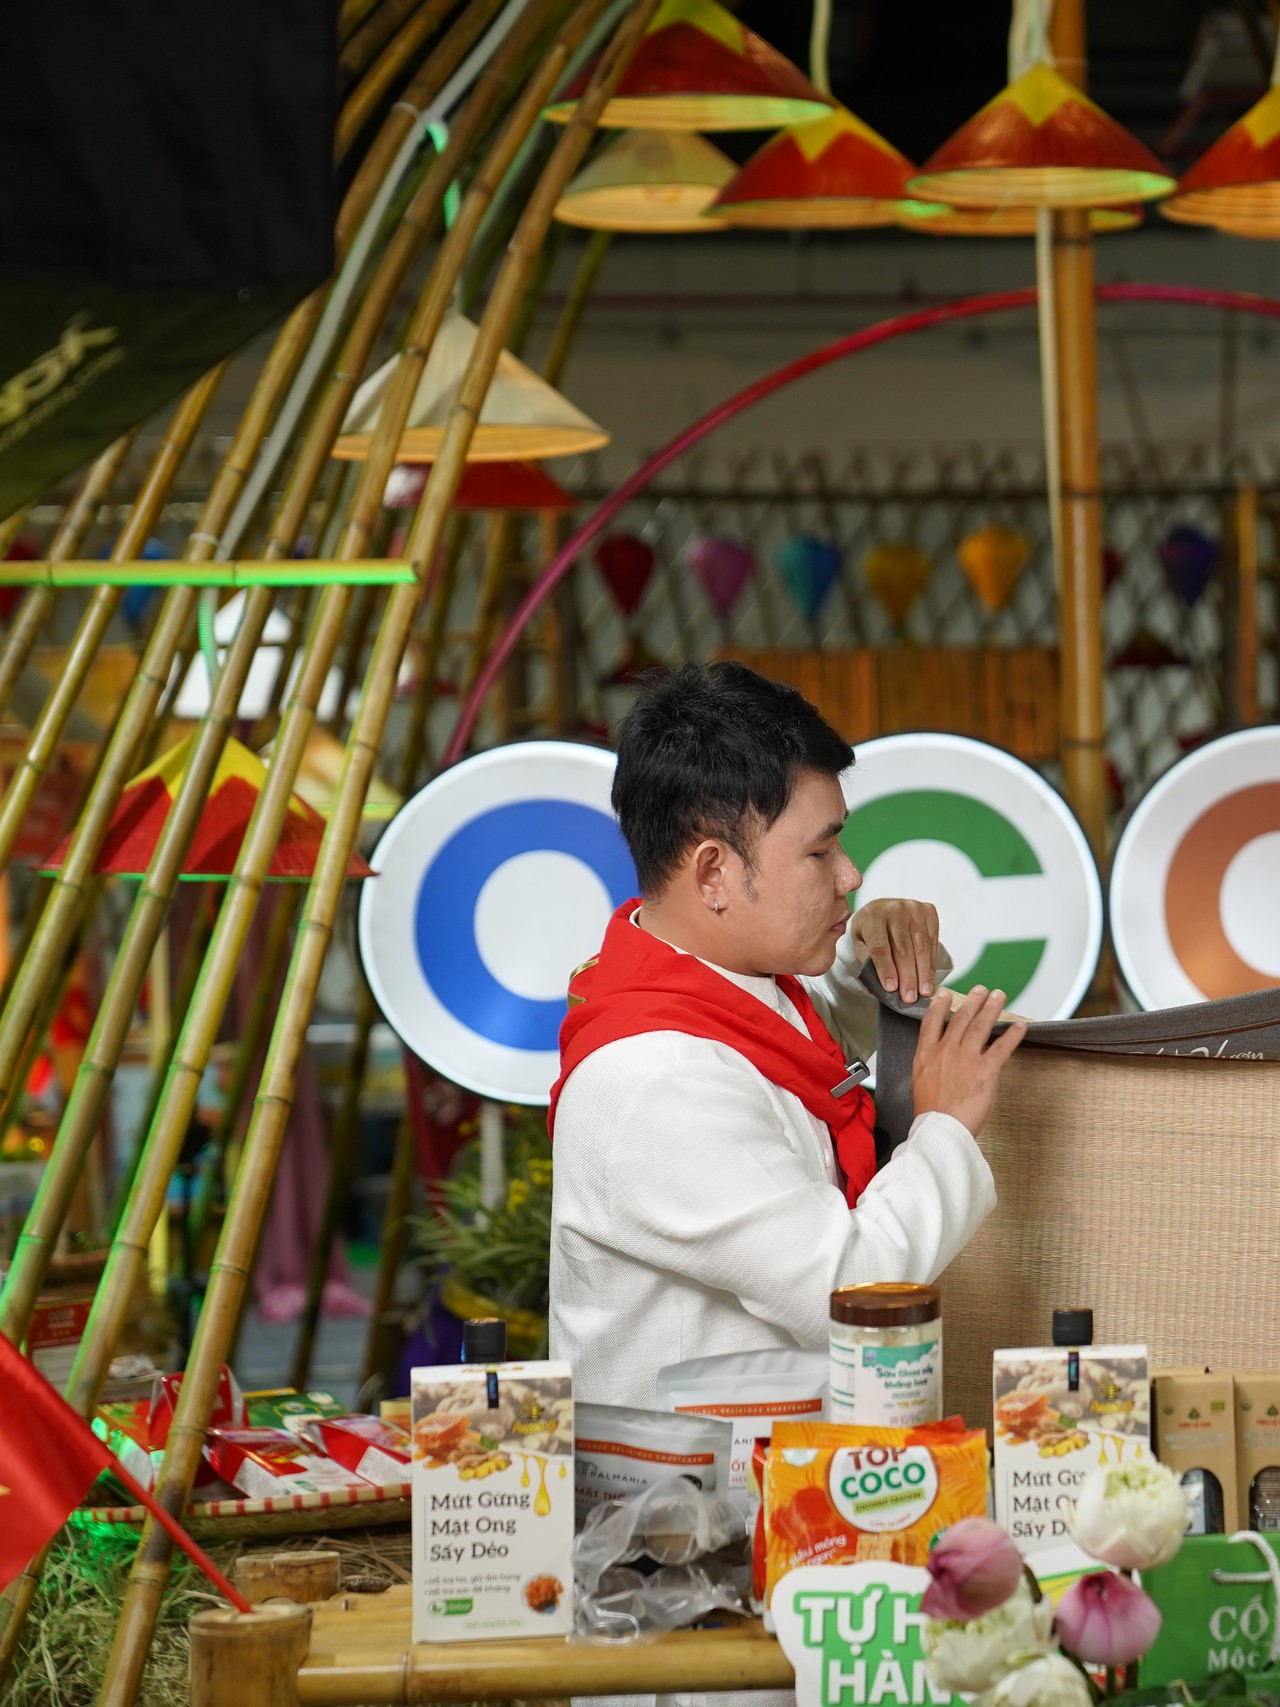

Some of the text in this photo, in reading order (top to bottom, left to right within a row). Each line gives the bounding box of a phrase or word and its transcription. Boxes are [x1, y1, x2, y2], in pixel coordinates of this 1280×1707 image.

[847, 1448, 908, 1471] TOP
[840, 1462, 926, 1498] COCO
[1012, 1469, 1052, 1488] Mứt
[430, 1490, 531, 1512] Mứt Gừng
[1012, 1496, 1051, 1516] Mật
[430, 1515, 517, 1539] Mật Ong
[1012, 1519, 1046, 1541] Sấy
[430, 1538, 510, 1565] Sấy Dẻo
[799, 1588, 885, 1657] TỰ
[828, 1648, 953, 1704] HÀN
